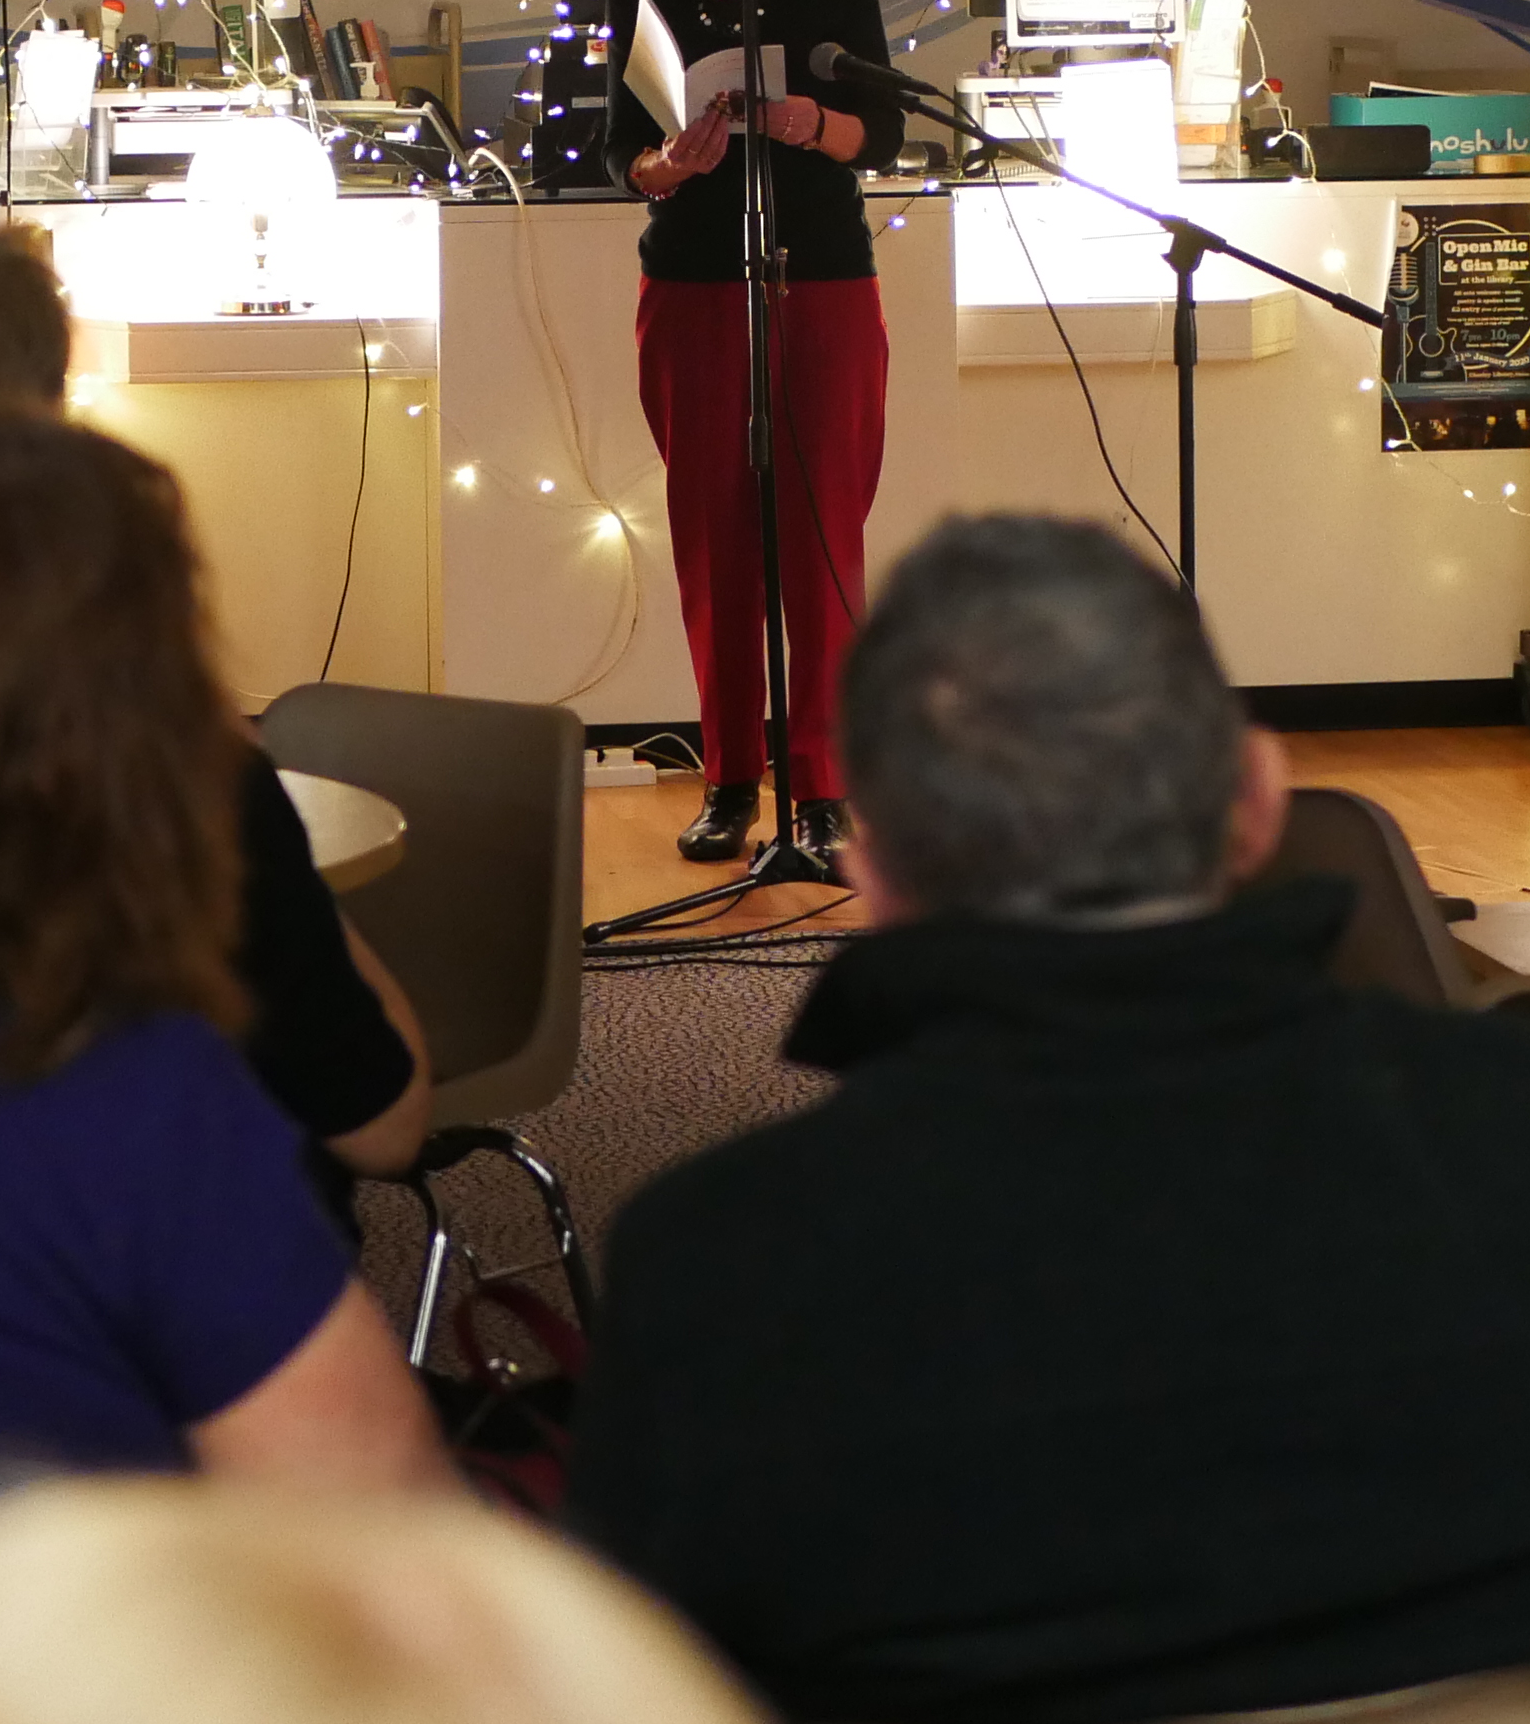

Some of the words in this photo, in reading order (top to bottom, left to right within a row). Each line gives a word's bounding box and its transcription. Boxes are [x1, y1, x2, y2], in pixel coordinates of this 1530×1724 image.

[1442, 240, 1492, 257] Open
[1493, 239, 1528, 253] Mic
[1443, 258, 1458, 273] &
[1461, 258, 1493, 272] Gin
[1496, 258, 1529, 272] Bar
[1471, 276, 1485, 284] the
[1486, 275, 1515, 285] library
[1490, 328, 1521, 342] 10pm
[1473, 352, 1508, 368] January
[1509, 356, 1530, 367] 2020
